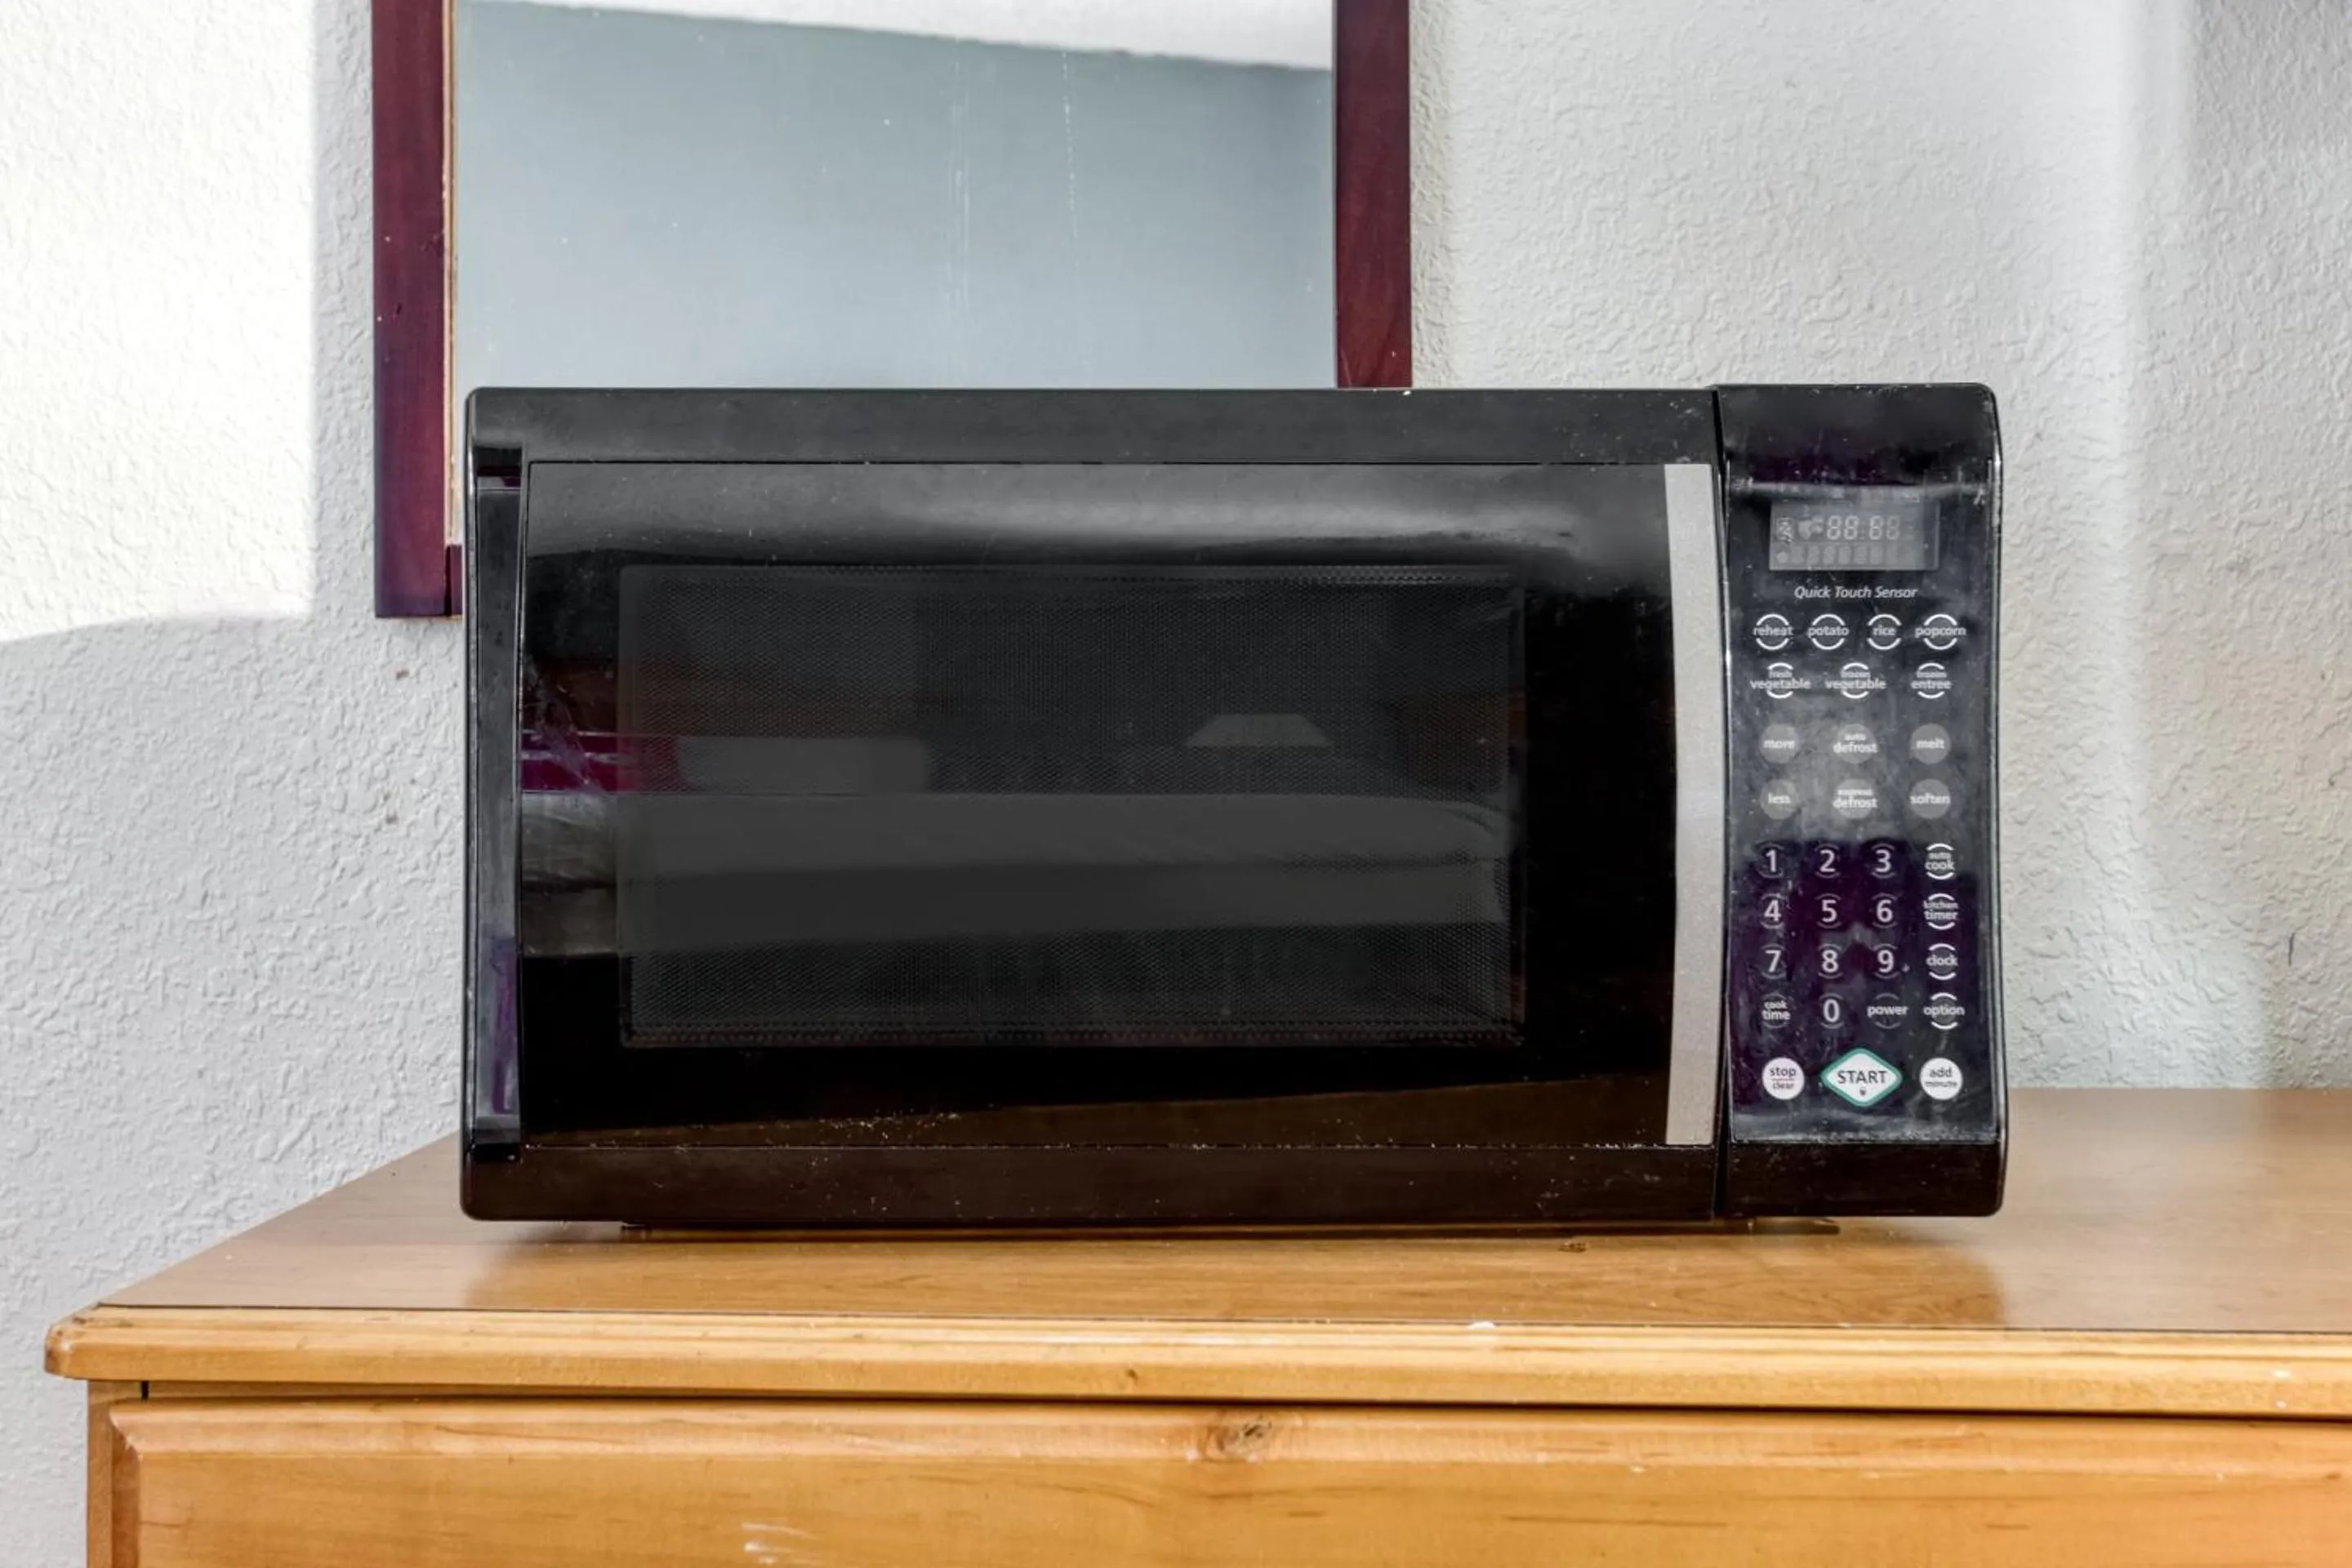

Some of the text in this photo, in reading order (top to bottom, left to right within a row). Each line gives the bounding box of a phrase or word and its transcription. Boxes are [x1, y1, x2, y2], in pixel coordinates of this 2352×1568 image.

[1794, 586, 1918, 599] Quick Touch Sensor
[1753, 626, 1793, 636] reheat
[1808, 626, 1850, 637] potato
[1873, 626, 1895, 635] rice
[1915, 626, 1967, 637] popcorn
[1750, 679, 1811, 691] vegetable
[1825, 679, 1886, 691] vegetable
[1910, 679, 1952, 689] entree
[1763, 738, 1796, 749] more
[1833, 741, 1878, 754] defrost
[1916, 737, 1944, 749] melt
[1768, 792, 1791, 804] less
[1833, 796, 1878, 808] defrost
[1910, 792, 1950, 804] soften
[1766, 850, 1778, 872] 1
[1820, 849, 1835, 872] 2
[1876, 849, 1891, 873] 3
[1924, 858, 1954, 871] cook
[1764, 900, 1781, 921] 4
[1822, 900, 1837, 922] 5
[1877, 900, 1893, 922] 6
[1923, 911, 1958, 920] timer
[1766, 950, 1781, 973] 7
[1822, 950, 1839, 973] 8
[1878, 951, 1895, 973] 9
[1926, 955, 1958, 966] clock
[1764, 1000, 1787, 1009] cook
[1823, 999, 1840, 1022] 0
[1923, 1004, 1965, 1017] option
[1762, 1010, 1791, 1020] time
[1867, 1005, 1909, 1017] power
[1769, 1067, 1797, 1078] stop
[1838, 1070, 1888, 1085] START
[1929, 1067, 1953, 1079] add
